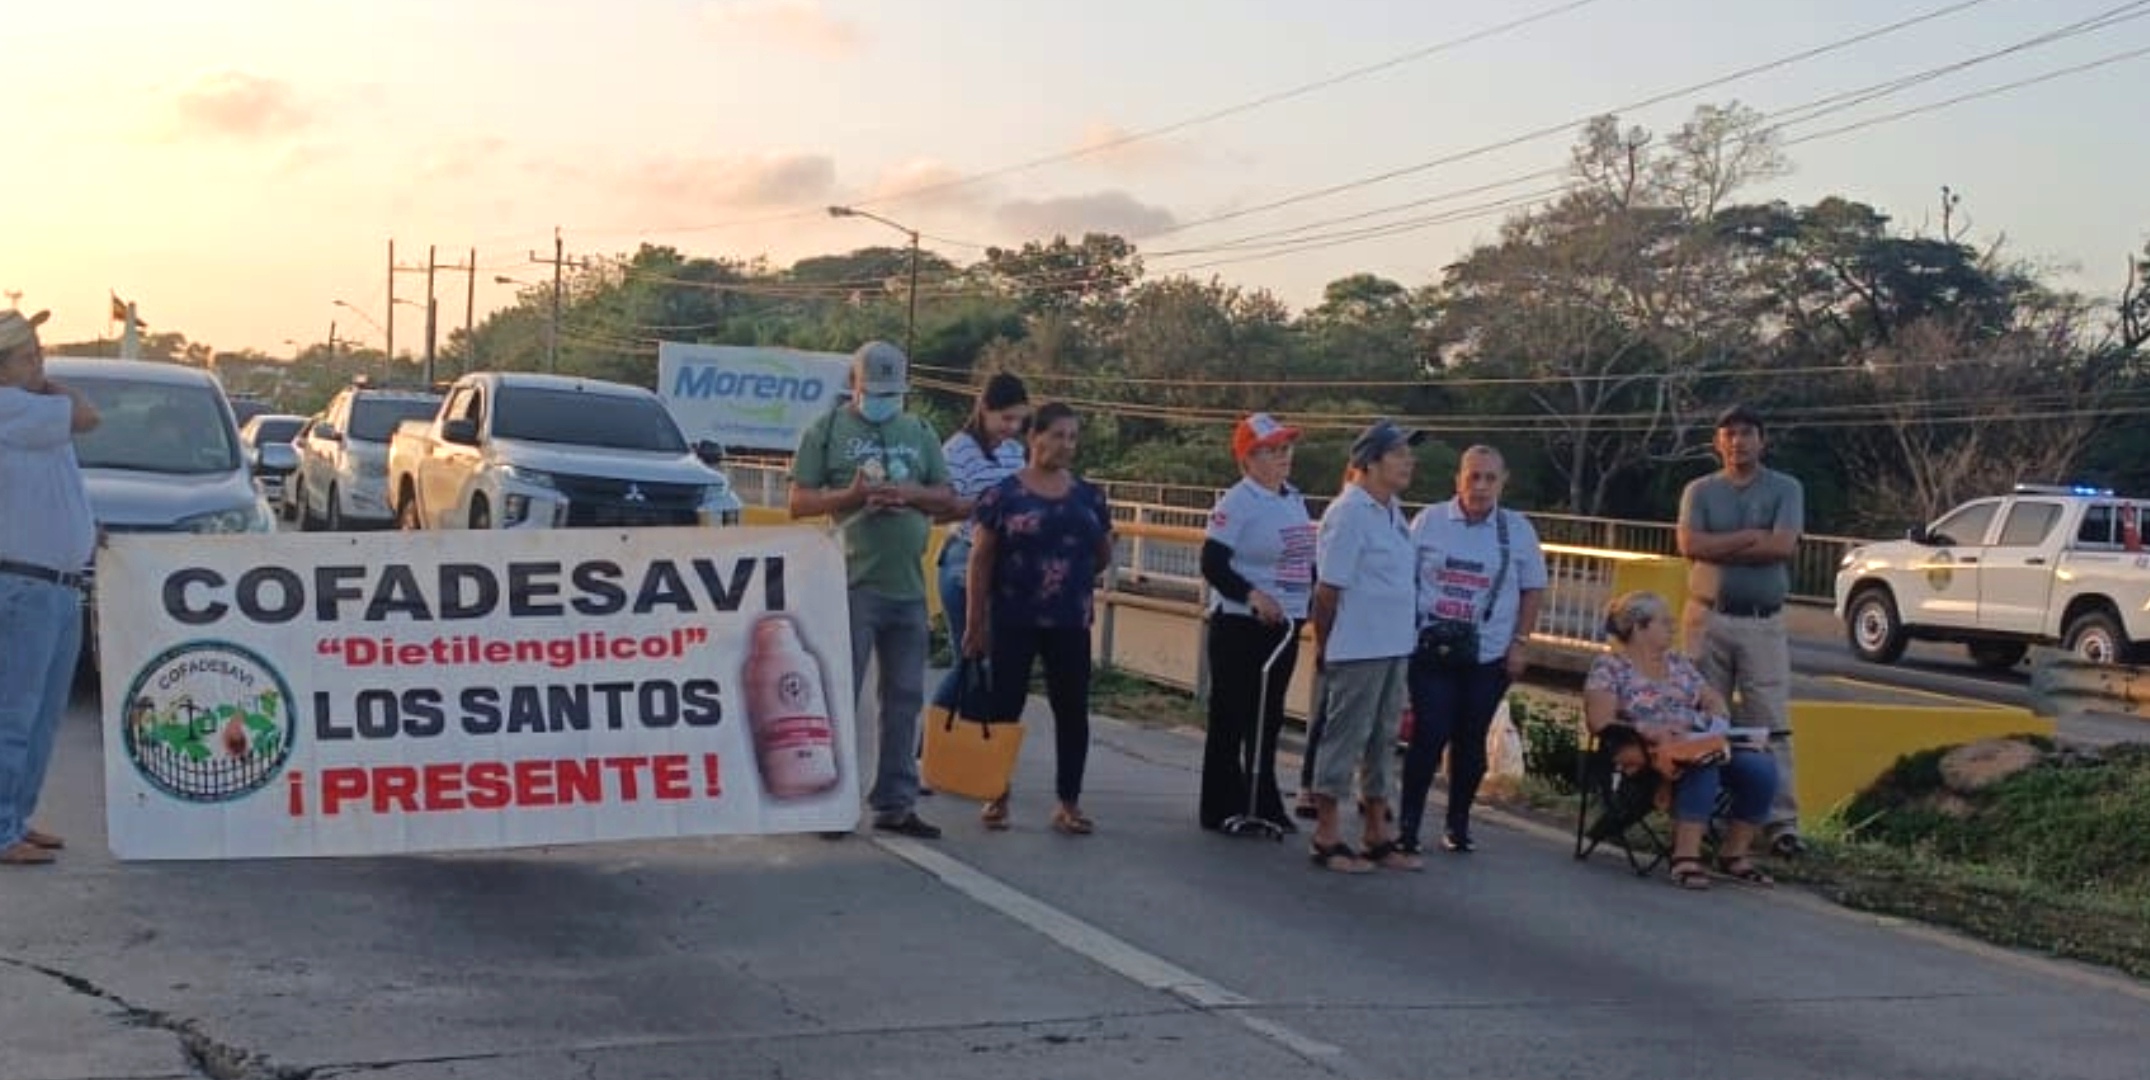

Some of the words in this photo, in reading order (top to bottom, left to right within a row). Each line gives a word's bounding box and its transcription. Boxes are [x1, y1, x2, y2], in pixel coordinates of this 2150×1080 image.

[674, 366, 824, 403] Moreno
[161, 556, 786, 626] COFADESAVI
[159, 658, 254, 690] COFADESAVI
[313, 687, 446, 742] LOS
[458, 678, 723, 736] SANTOS
